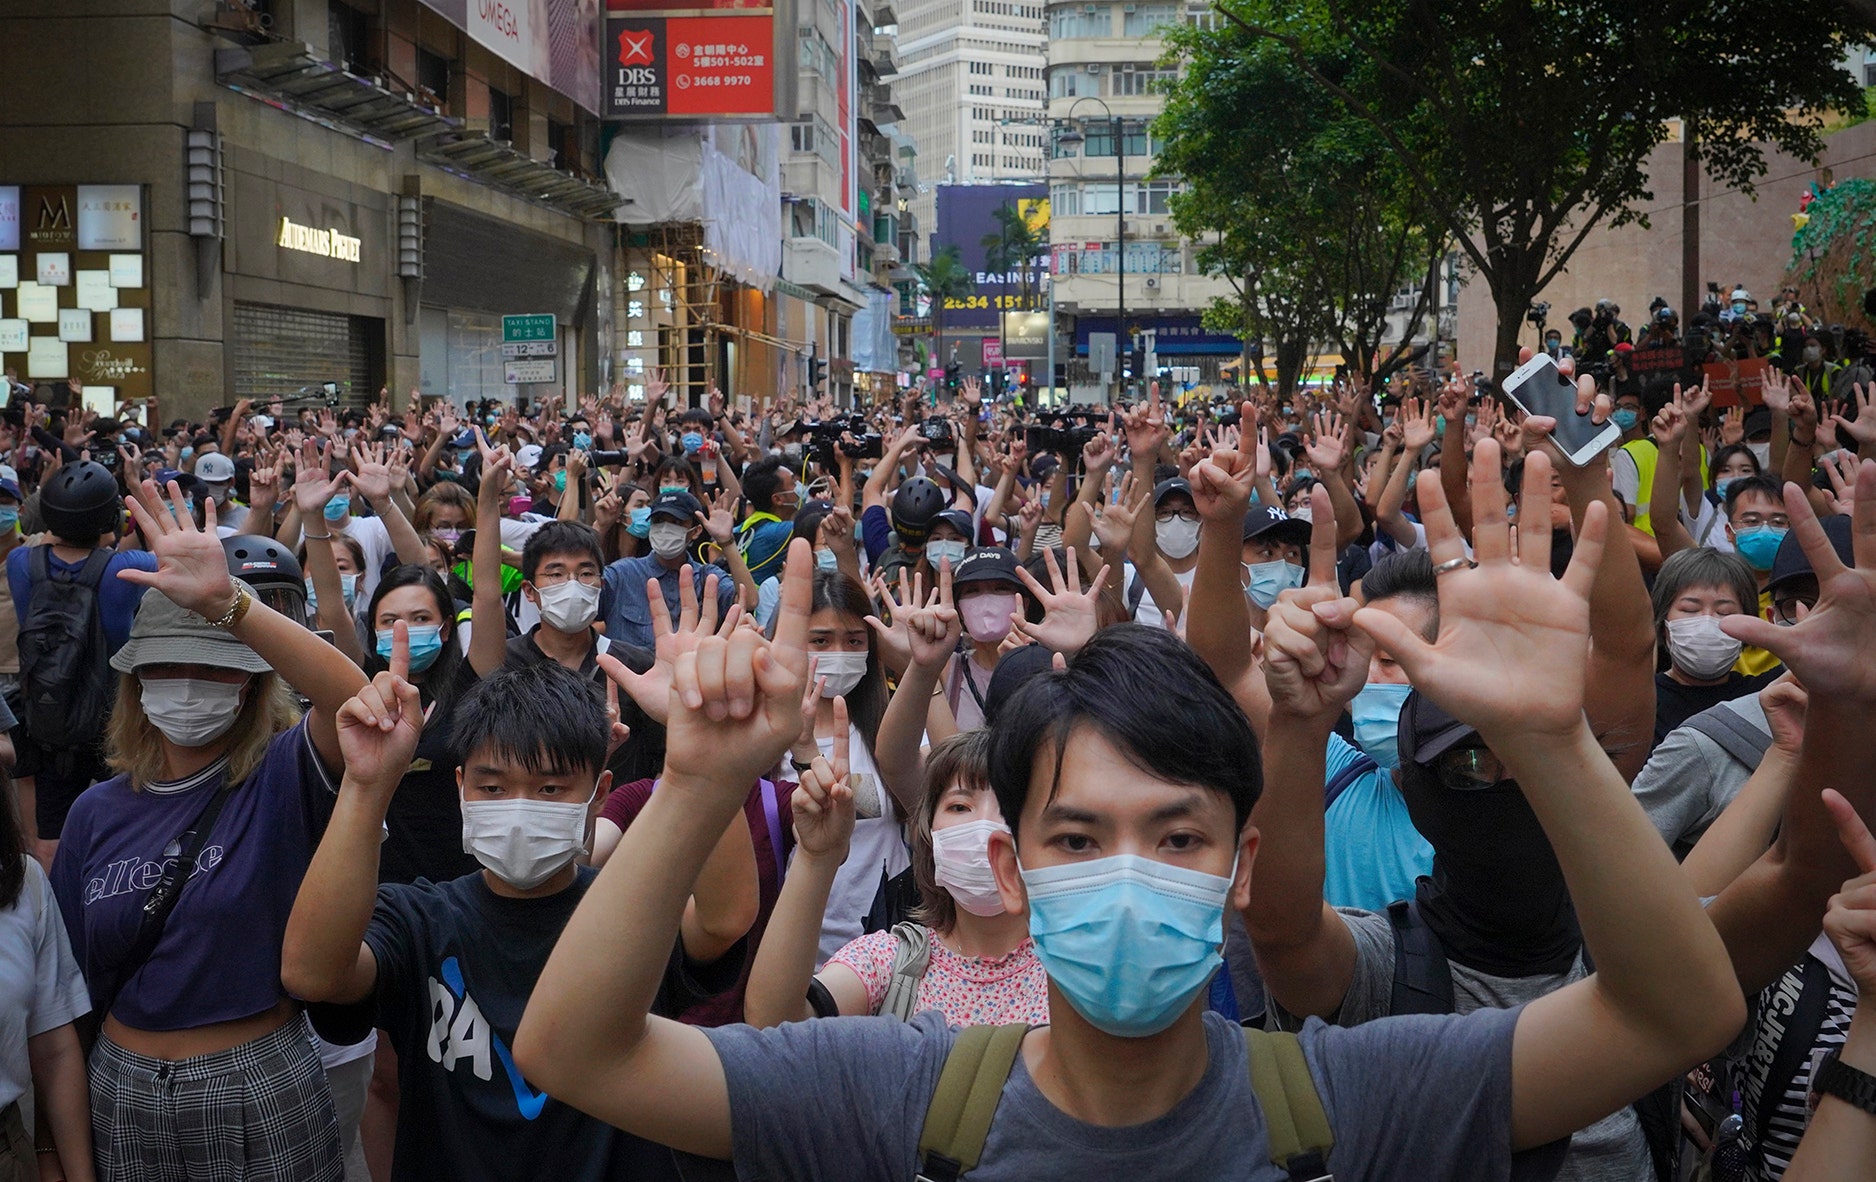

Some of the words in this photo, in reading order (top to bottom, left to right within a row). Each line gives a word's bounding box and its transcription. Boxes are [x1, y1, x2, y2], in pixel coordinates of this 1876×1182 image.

[618, 68, 656, 85] DBS
[693, 76, 720, 86] 3668
[724, 75, 751, 86] 9970
[614, 87, 660, 97] 星展財務
[615, 98, 630, 106] DBS
[631, 98, 660, 106] Finance
[279, 216, 330, 257] AUDEMARS
[330, 228, 361, 263] PIGUET
[968, 271, 1035, 284] EASING
[525, 318, 551, 326] STAND
[512, 327, 545, 337] 的士站
[547, 342, 554, 353] 6
[1267, 506, 1288, 520] NY
